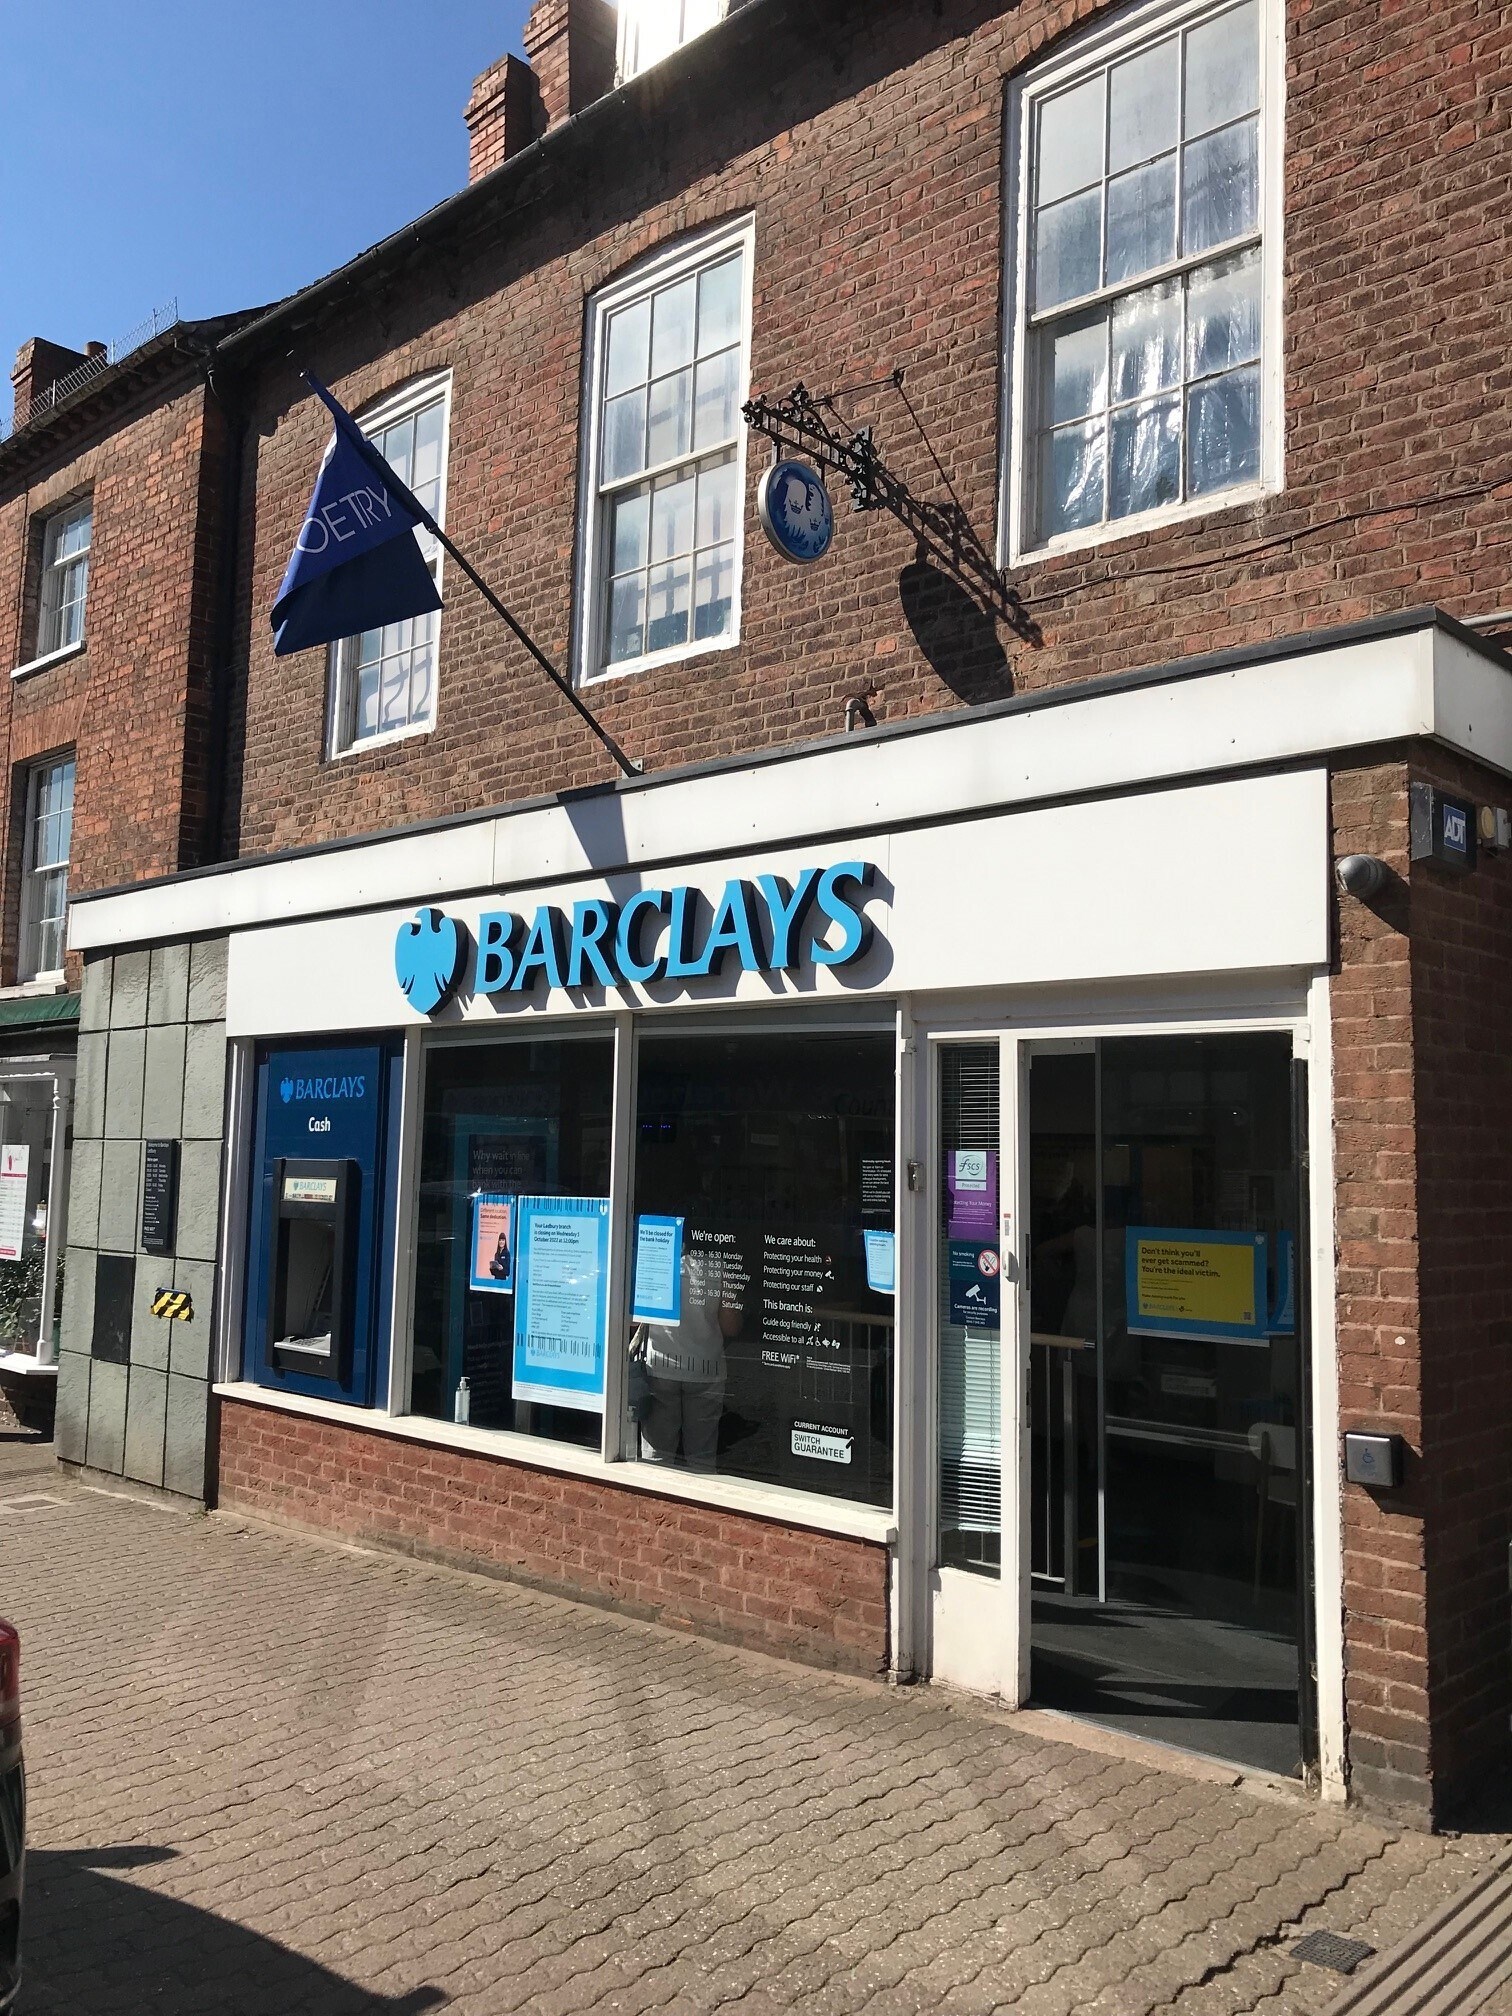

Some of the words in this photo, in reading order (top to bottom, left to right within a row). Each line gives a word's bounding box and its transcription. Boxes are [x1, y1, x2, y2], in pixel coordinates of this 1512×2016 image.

[297, 486, 392, 553] OETRY
[1444, 815, 1466, 844] ADT
[475, 861, 873, 994] BARCLAYS
[296, 1076, 365, 1099] BARCLAYS
[308, 1116, 331, 1132] Cash
[473, 1150, 490, 1162] Why
[492, 1151, 509, 1160] wait
[472, 1164, 493, 1174] when
[494, 1166, 508, 1176] you
[510, 1166, 522, 1174] can
[299, 1182, 327, 1192] BARCLAYS
[691, 1230, 713, 1242] We're
[714, 1232, 736, 1244] open:
[764, 1235, 775, 1244] We
[793, 1237, 816, 1247] about:
[723, 1252, 743, 1261] Monday
[764, 1252, 790, 1262] Protecting
[804, 1255, 822, 1263] health
[1162, 1248, 1180, 1256] think
[1181, 1250, 1201, 1258] you'll
[723, 1262, 743, 1271] Tuesday
[764, 1266, 790, 1276] Protecting
[804, 1271, 823, 1279] money
[722, 1272, 750, 1282] Wednesday
[1195, 1269, 1221, 1277] victim.
[722, 1281, 745, 1291] Thursday
[763, 1280, 790, 1291] Protecting
[722, 1291, 737, 1300] Friday
[722, 1300, 743, 1310] Saturday
[763, 1299, 778, 1310] This
[779, 1300, 803, 1312] branch
[804, 1304, 813, 1313] is:
[762, 1317, 778, 1326] Guide
[780, 1320, 790, 1329] dog
[791, 1320, 812, 1331] friendly
[762, 1332, 790, 1342] Accessible
[762, 1350, 779, 1362] FREE
[794, 1420, 820, 1430] CURRENT
[821, 1426, 848, 1435] ACCOUNT
[794, 1434, 820, 1445] SWITCH
[794, 1442, 844, 1459] GUARANTEE
